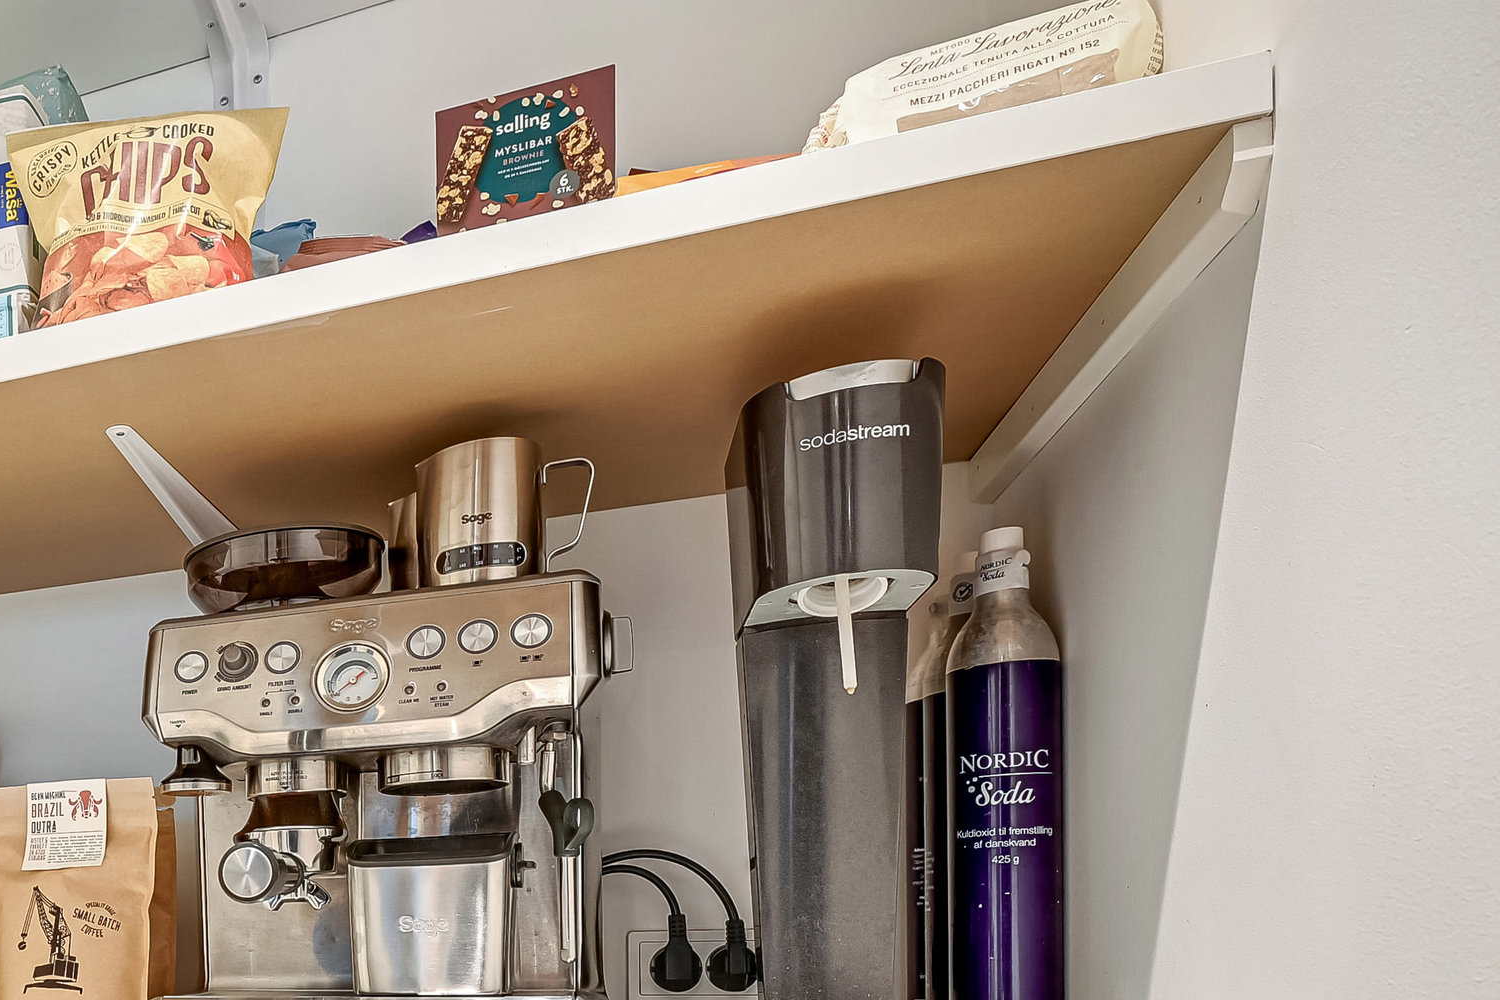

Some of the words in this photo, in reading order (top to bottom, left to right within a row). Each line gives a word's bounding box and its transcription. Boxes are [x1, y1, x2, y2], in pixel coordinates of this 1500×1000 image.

[893, 64, 969, 92] ECCEZIONALE
[972, 48, 1019, 67] TENUTA
[1023, 37, 1053, 52] ALLA
[1057, 14, 1116, 41] COTTURA
[930, 38, 971, 57] METODO
[888, 51, 962, 81] Lenta
[909, 92, 946, 107] MEZZI
[949, 70, 1011, 97] PACCHERI
[1013, 55, 1056, 75] RIGATI
[1079, 38, 1101, 52] 152
[495, 112, 551, 136] salling
[81, 132, 121, 169] KETTLE
[162, 122, 215, 139] COOKED
[494, 135, 553, 158] MYSLIBAR
[32, 145, 73, 192] CRISPY
[502, 149, 545, 167] BROWNIE
[81, 136, 214, 219] CHIPS
[560, 173, 568, 187] 6
[556, 185, 574, 195] STK.
[799, 422, 911, 452] sodastream
[461, 512, 493, 525] Sage
[981, 556, 1013, 572] NORDIC
[408, 664, 442, 673] PROGRAMME
[959, 749, 1049, 775] NORDIC
[975, 780, 1036, 807] Soda
[31, 802, 64, 818] BRAZIL
[956, 828, 996, 839] Kuldioxid
[998, 827, 1007, 836] til
[1008, 825, 1053, 837] fremstilling
[973, 840, 983, 849] af
[985, 838, 1037, 848] danskvand
[991, 855, 1011, 864] 425
[1013, 856, 1020, 865] g
[72, 907, 96, 924] SMALL
[97, 915, 121, 932] BATCH
[80, 923, 104, 938] COFFEE
